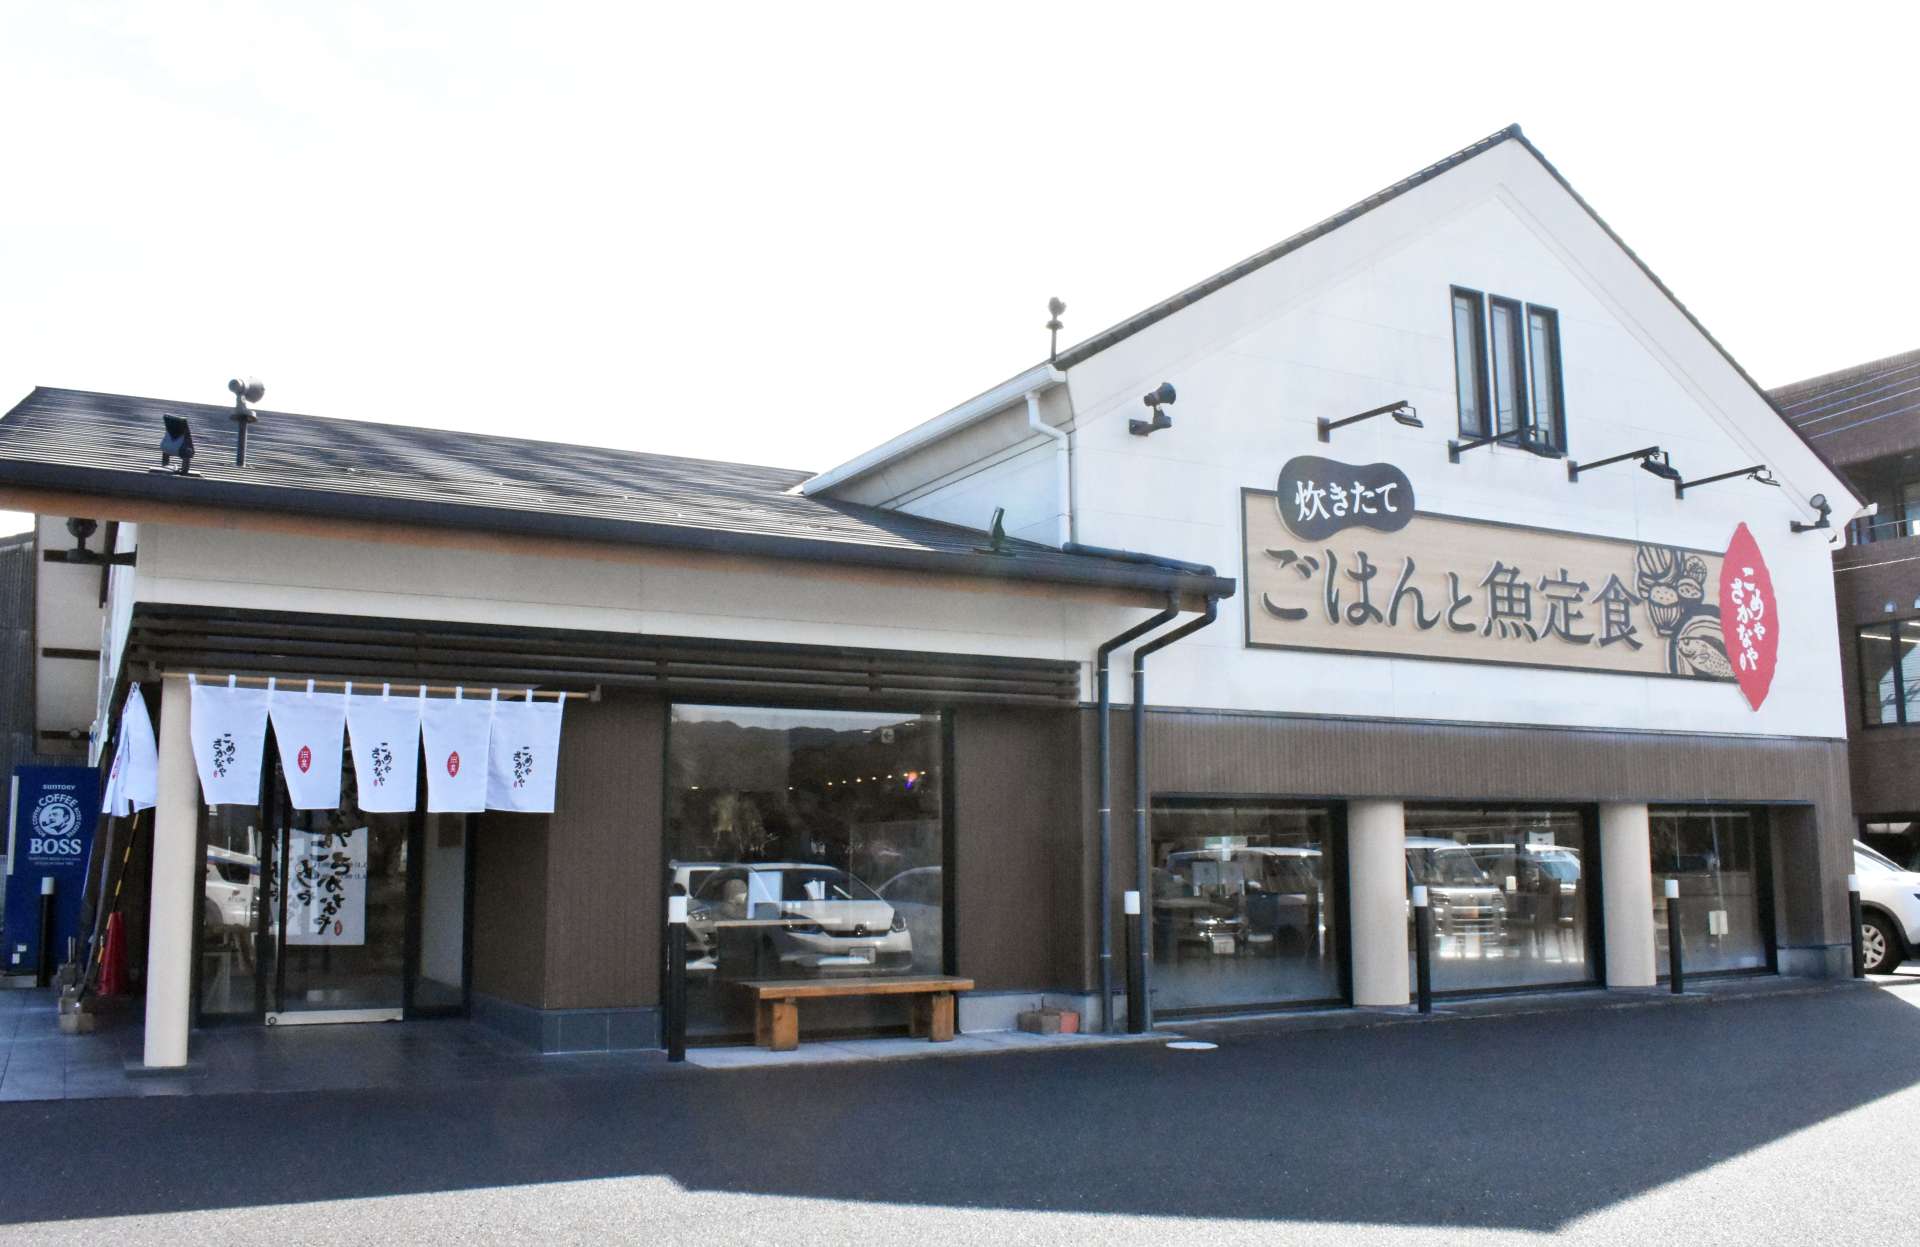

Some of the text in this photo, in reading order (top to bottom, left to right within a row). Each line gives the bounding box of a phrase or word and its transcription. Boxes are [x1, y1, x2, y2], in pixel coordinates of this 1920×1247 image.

[1295, 480, 1398, 521] 炊きたて
[1261, 548, 1642, 651] ごはんと魚定食
[1730, 578, 1759, 671] さかなや
[1742, 567, 1766, 640] こめや
[39, 793, 78, 806] COFFEE
[30, 838, 82, 855] BOSS
